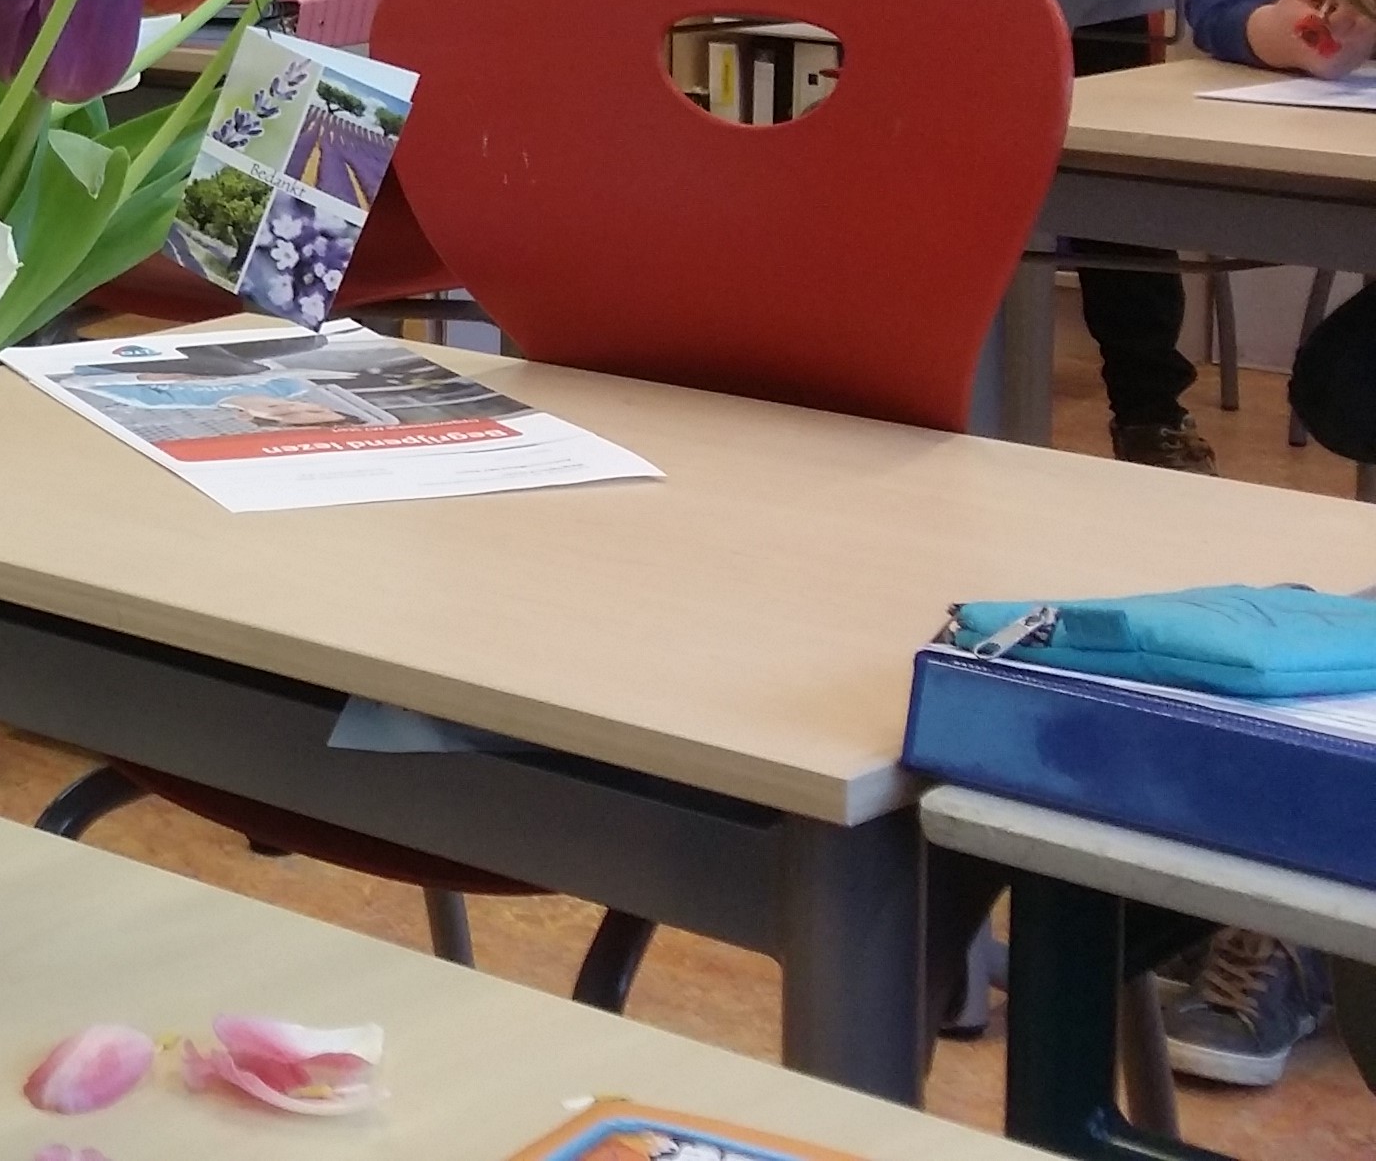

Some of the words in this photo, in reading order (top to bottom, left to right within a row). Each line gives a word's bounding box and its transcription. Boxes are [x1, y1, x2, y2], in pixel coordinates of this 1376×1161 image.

[251, 163, 306, 197] Bedankt
[261, 440, 344, 455] lezen
[346, 428, 508, 451] Begrijpend
